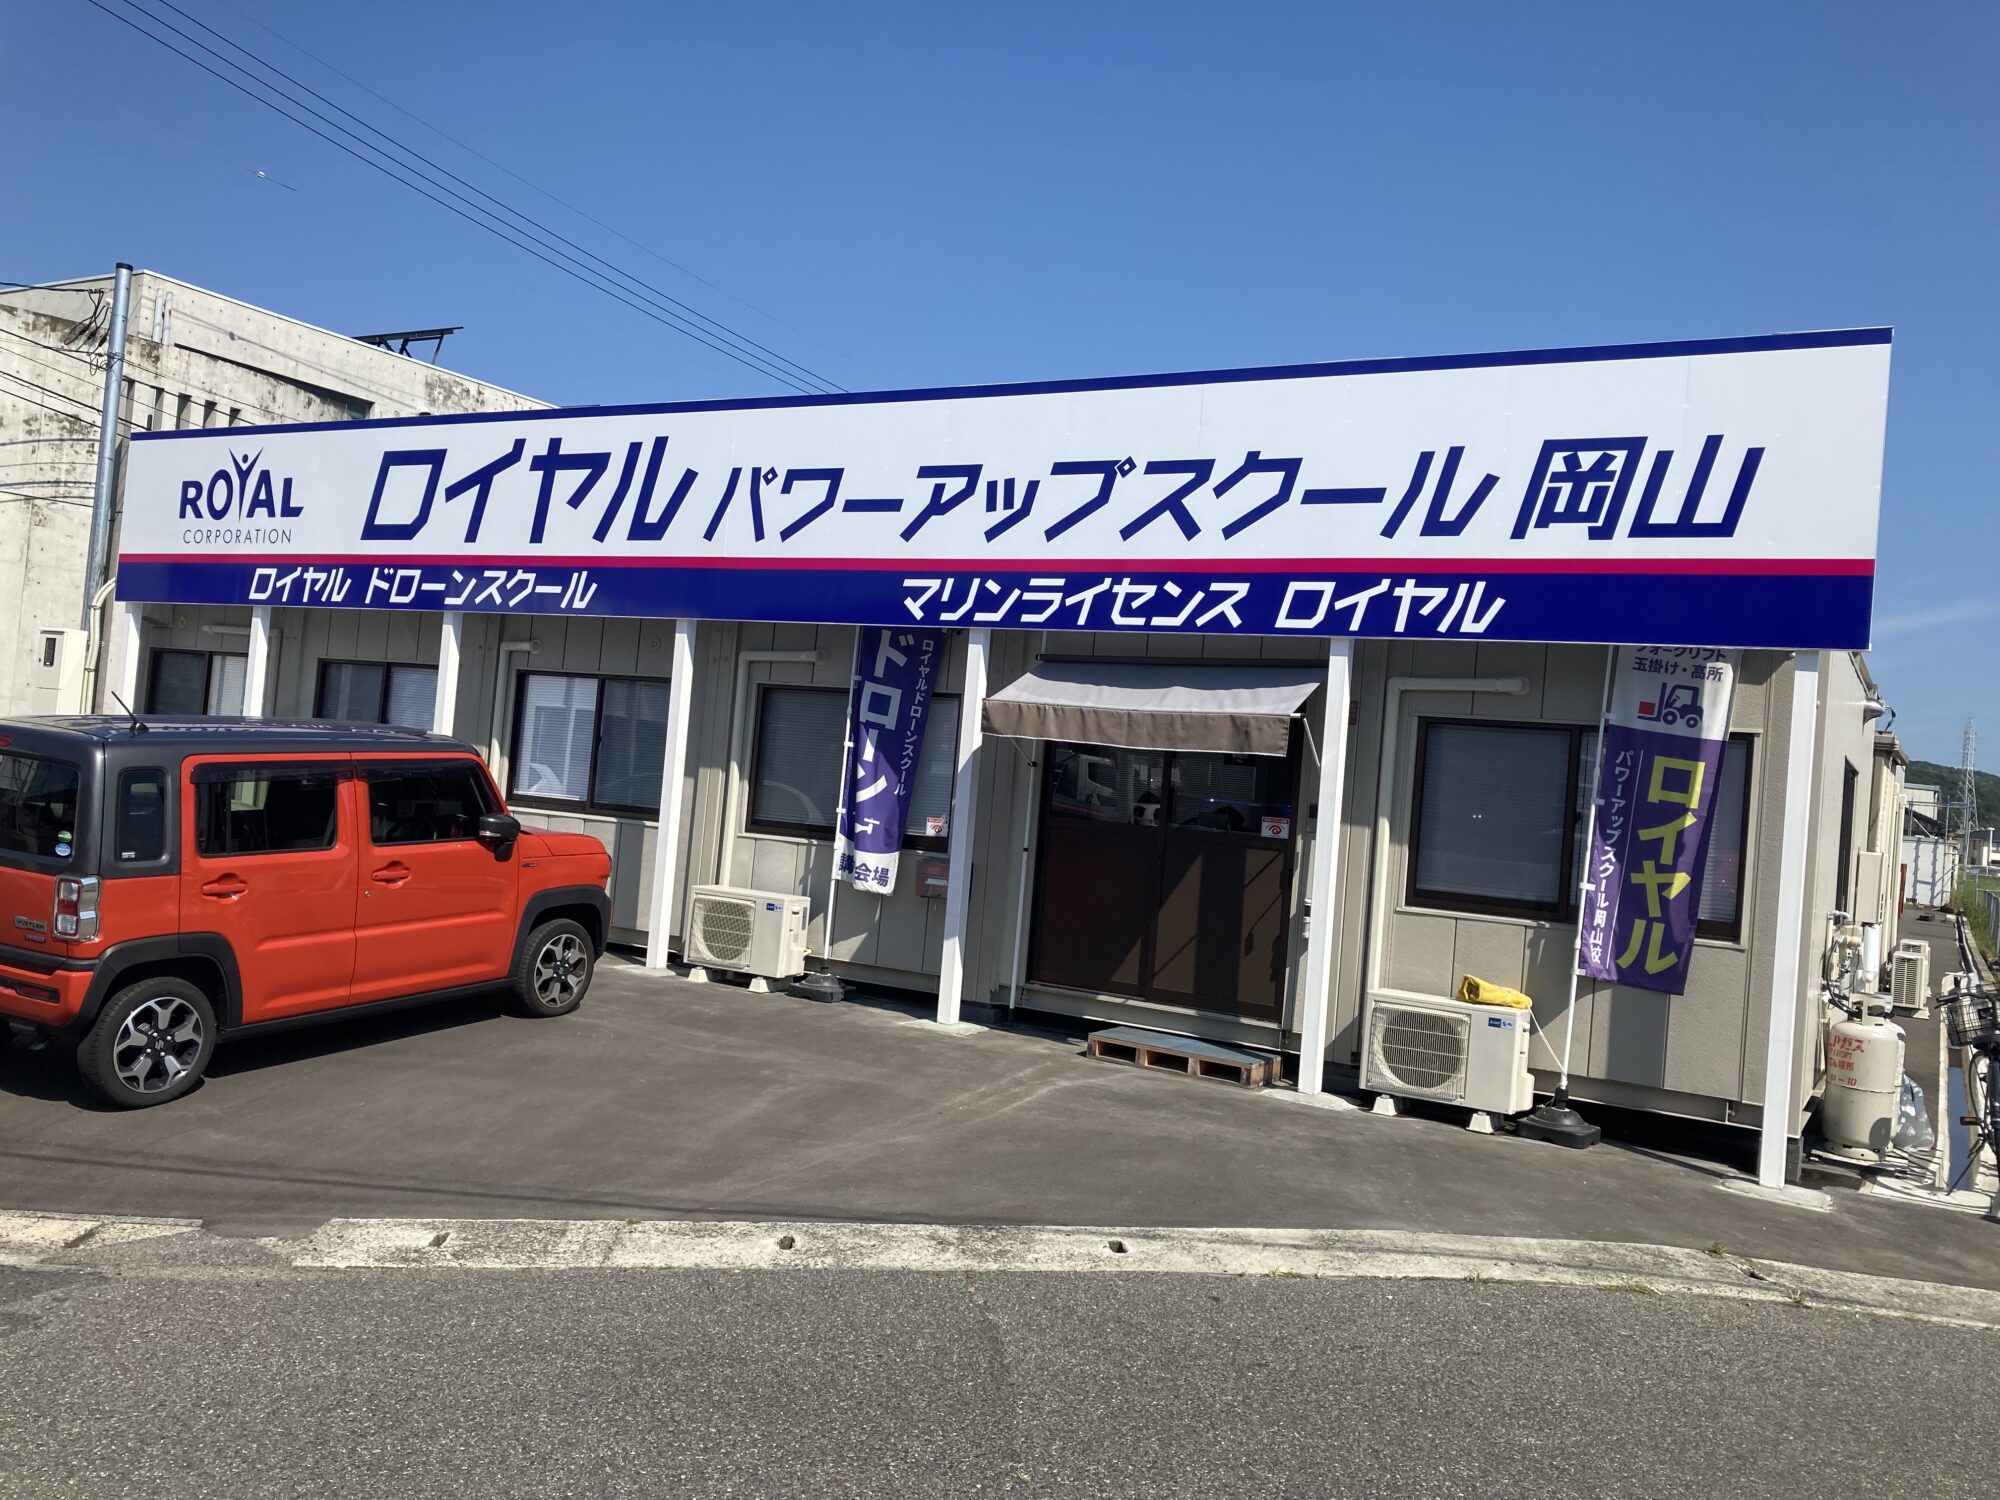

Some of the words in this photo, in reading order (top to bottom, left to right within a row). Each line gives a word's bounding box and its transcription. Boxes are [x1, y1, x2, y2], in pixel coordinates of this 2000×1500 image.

[179, 447, 304, 521] ROYAL
[360, 437, 698, 543] ロイヤル
[703, 444, 1500, 543] パワーアップスクール
[1510, 433, 1766, 540] 岡山
[182, 528, 292, 544] CORPORATION
[248, 567, 352, 603] ロイヤル
[364, 568, 597, 610] ドローンスクール
[902, 577, 1250, 628] マリンライセンス
[1275, 577, 1506, 634] ロイヤル
[856, 629, 915, 803] ドローン
[893, 639, 934, 796] ロイヤルドローンスクール
[1616, 755, 1706, 975] ロイヤル
